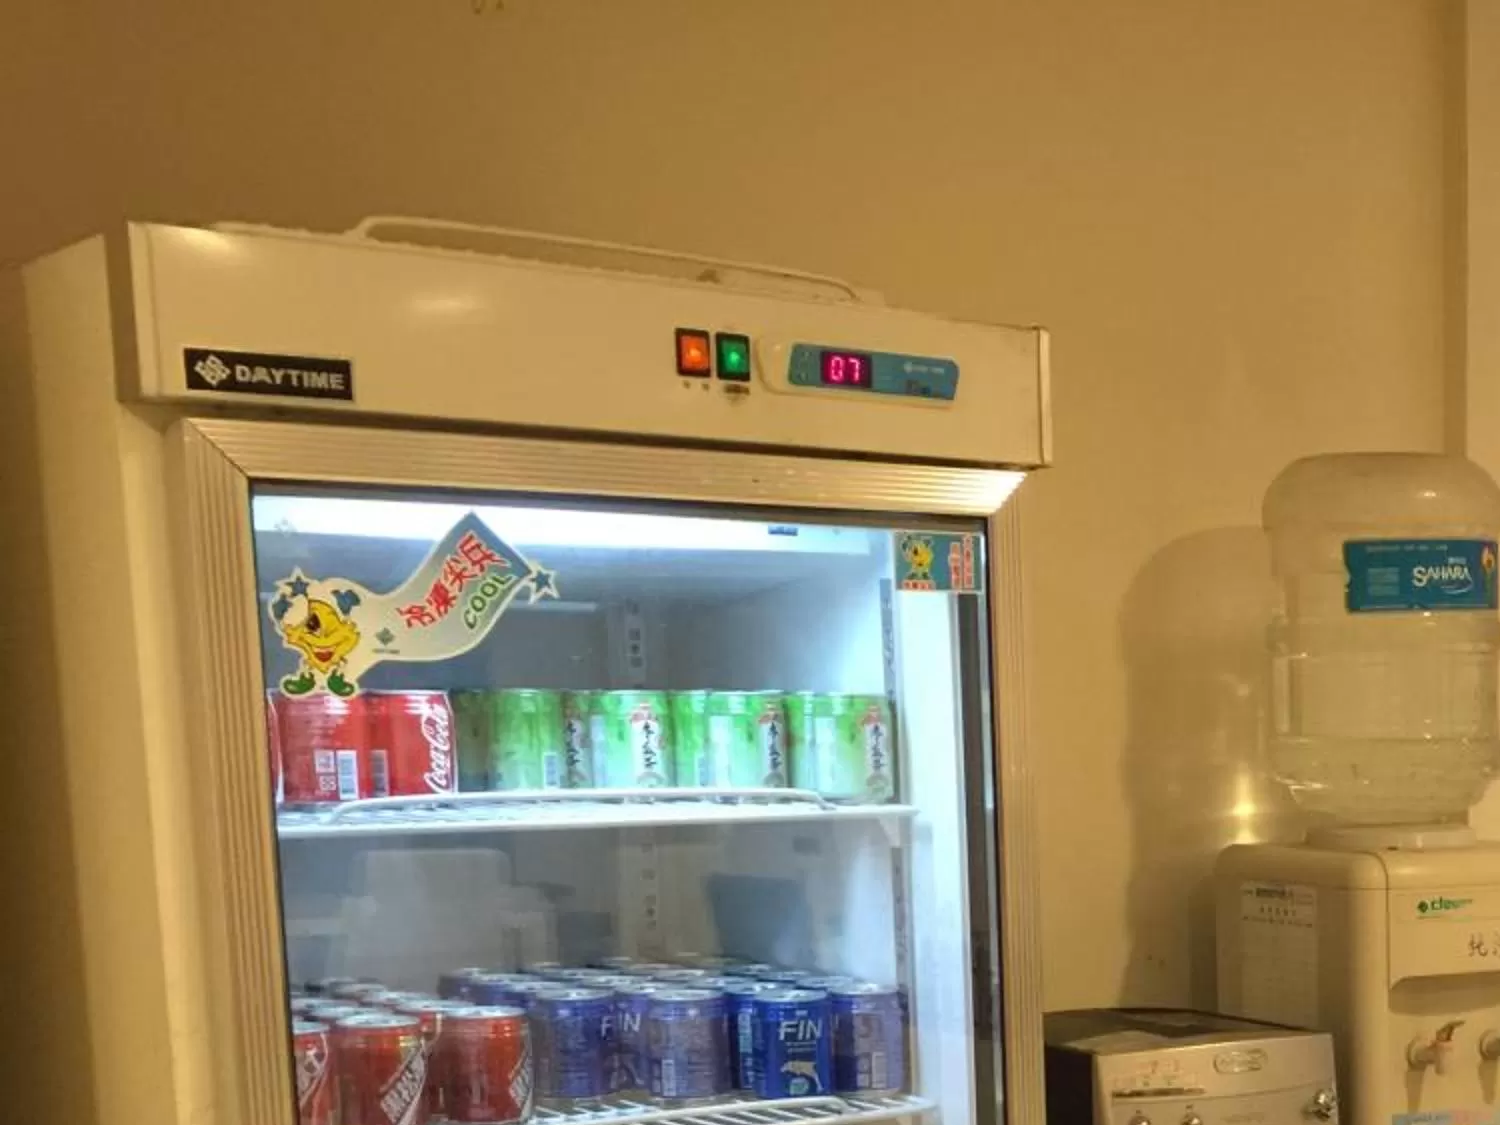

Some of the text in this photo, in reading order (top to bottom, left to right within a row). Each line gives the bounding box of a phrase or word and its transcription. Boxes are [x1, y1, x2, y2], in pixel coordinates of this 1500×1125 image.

[234, 364, 345, 390] DAYTIME
[830, 356, 862, 382] 07
[1412, 565, 1472, 588] SAHARA
[462, 574, 517, 630] COOL
[777, 1018, 824, 1042] FIN
